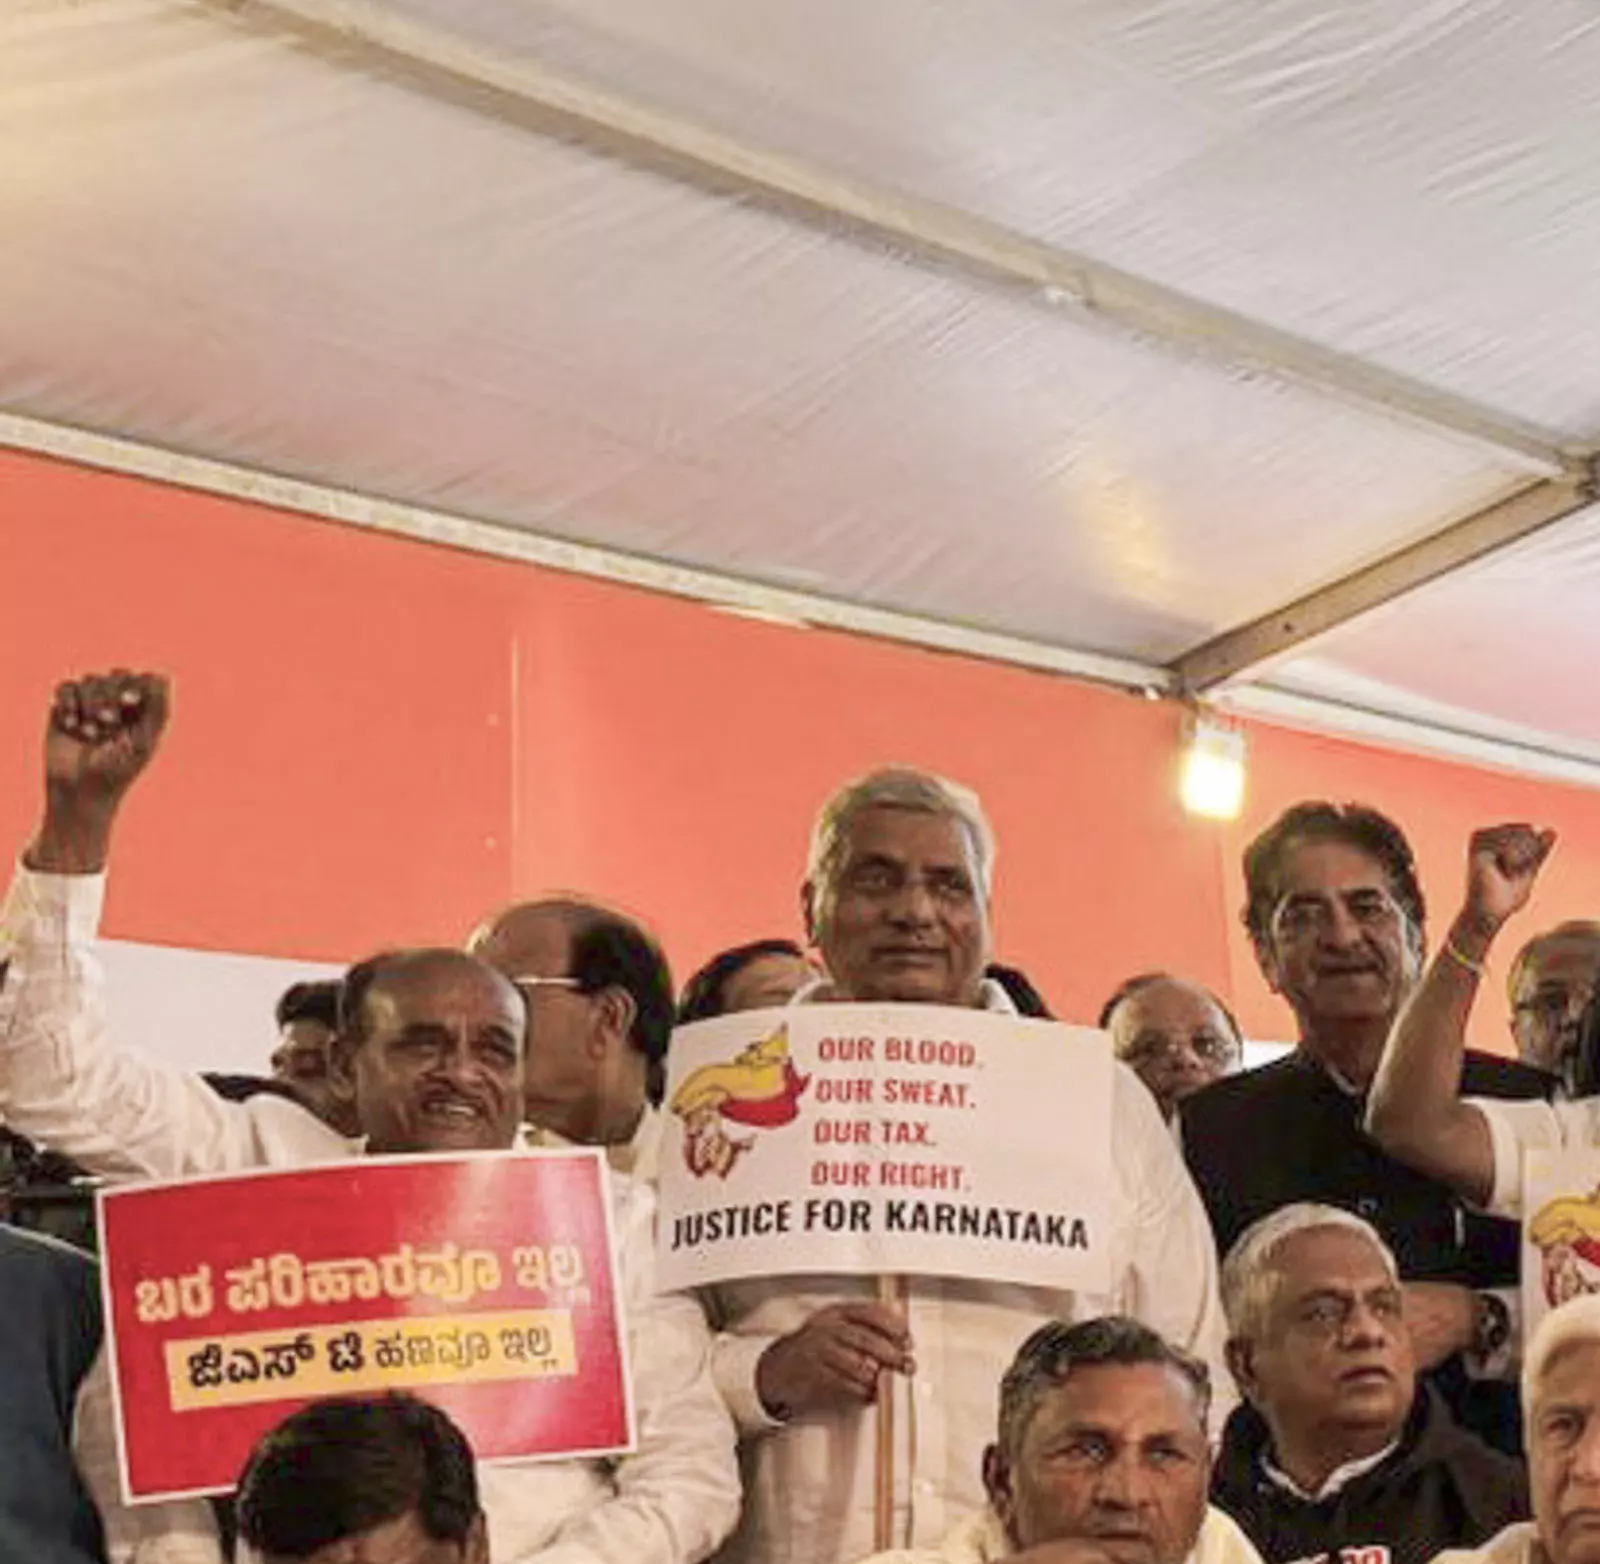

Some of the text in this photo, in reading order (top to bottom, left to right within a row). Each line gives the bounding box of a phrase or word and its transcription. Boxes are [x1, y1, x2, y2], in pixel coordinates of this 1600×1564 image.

[818, 1037, 984, 1067] OUR BLOOD.
[815, 1079, 977, 1109] OUR SWEAT.
[813, 1122, 937, 1147] OUR TAX.
[811, 1162, 972, 1191] OUR RIGHT.
[671, 1200, 1088, 1251] JUSTICE FOR KARNATAKA
[134, 1241, 591, 1325] ಬರ ಪರಿಹಾರವೂ ಇಲ್ಲ
[502, 1324, 558, 1369] ಇಲ್ಲ
